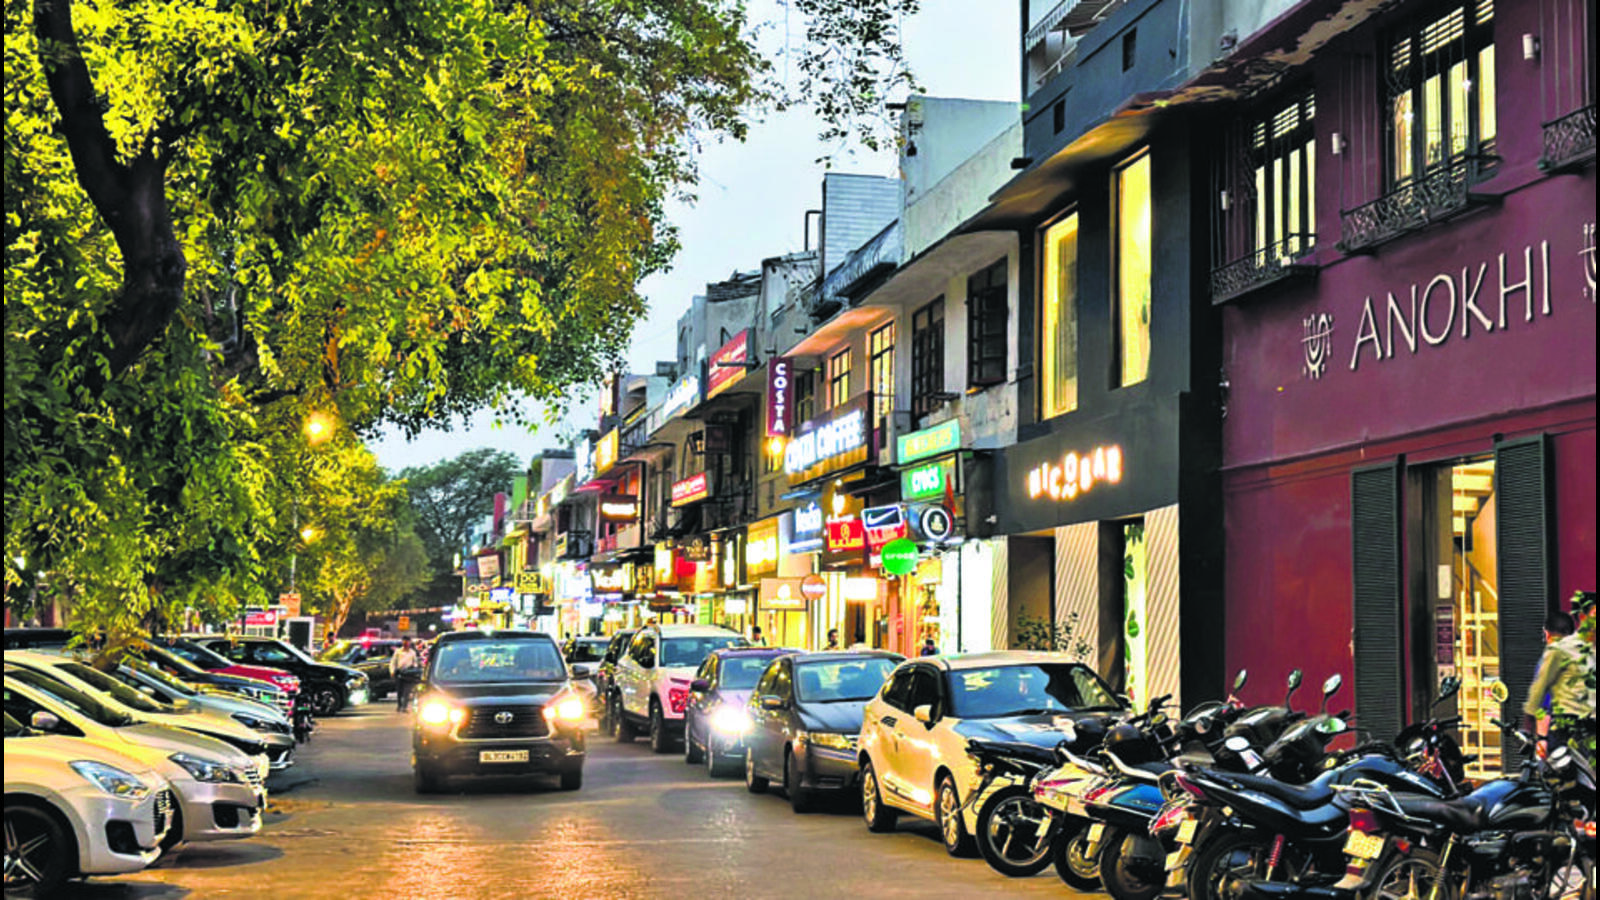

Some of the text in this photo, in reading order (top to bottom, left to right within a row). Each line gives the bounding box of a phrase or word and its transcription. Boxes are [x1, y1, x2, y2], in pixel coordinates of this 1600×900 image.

[1349, 239, 1551, 371] ANOKHI
[773, 362, 788, 432] COSTA
[1027, 444, 1122, 500] NICOBAR
